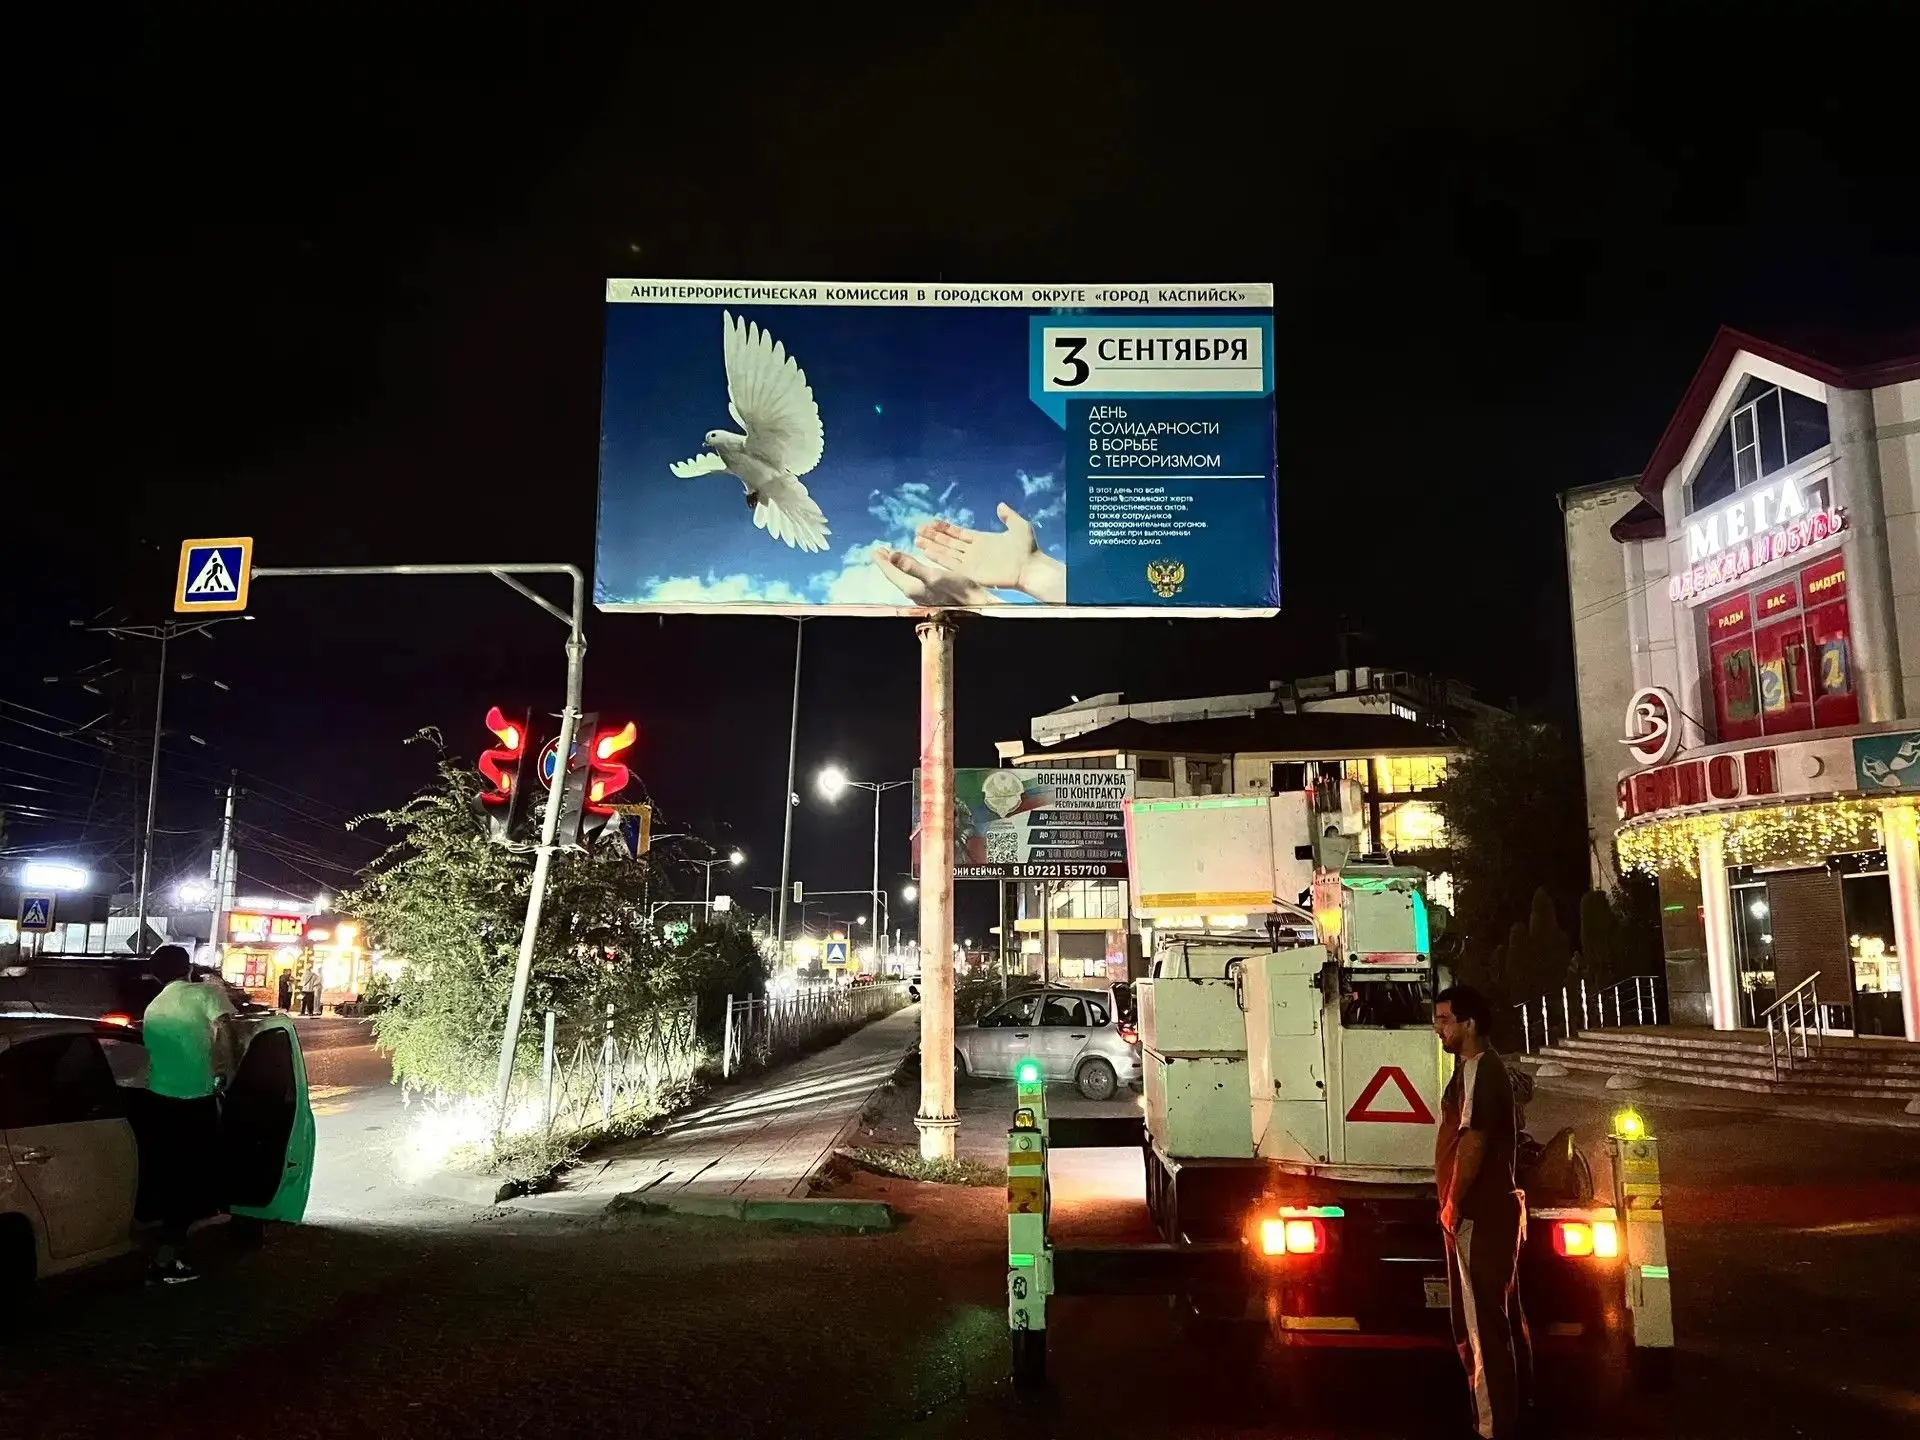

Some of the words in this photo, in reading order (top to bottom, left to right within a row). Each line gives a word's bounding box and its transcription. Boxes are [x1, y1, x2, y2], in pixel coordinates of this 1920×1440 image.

[630, 285, 817, 300] АНТИТЕРРОРИСТИЧЕСКАЯ
[826, 287, 908, 301] КОМИССИЯ
[917, 289, 926, 301] В
[934, 289, 1024, 304] ГОРОДСКОМ
[1031, 290, 1086, 302] ОКРУГЕ
[1095, 290, 1150, 304] «ГОРОД
[1158, 288, 1246, 302] КАСПИЙСК»
[1052, 337, 1090, 387] 3
[1097, 338, 1248, 361] СЕНТЯБРЯ
[1088, 405, 1127, 421] ДЕНЬ
[1088, 422, 1220, 436] СОЛИДАРНОСТИ
[1089, 438, 1098, 451] В
[1102, 438, 1158, 451] БОРЬБЕ
[1088, 454, 1101, 468] С
[1105, 454, 1221, 468] ТЕРРОРИЗМОМ
[1113, 487, 1133, 495] день
[1121, 513, 1172, 521] сотрудников
[1687, 478, 1808, 564] МЕГА
[1089, 538, 1137, 546] служебного
[1669, 545, 1749, 601] ОДЕЖДА
[1771, 507, 1843, 559] ОБУВЬ
[1718, 610, 1744, 628] РАДЫ
[1766, 593, 1787, 609] ВАС
[1037, 773, 1081, 785] ВОЕННАЯ
[1083, 773, 1126, 785] СЛУЖБА
[1055, 787, 1068, 799] ПО
[1070, 787, 1126, 799] КОНТРАКТУ
[1055, 800, 1095, 809] РЕСПУБЛИКА
[1096, 801, 1121, 809] ДАГЕСТ
[952, 867, 969, 876] ОНИ
[970, 865, 1006, 876] СЕЙЧАС:
[1012, 865, 1020, 876] 8
[1023, 865, 1061, 877] (8722)
[1064, 865, 1107, 876] 557700
